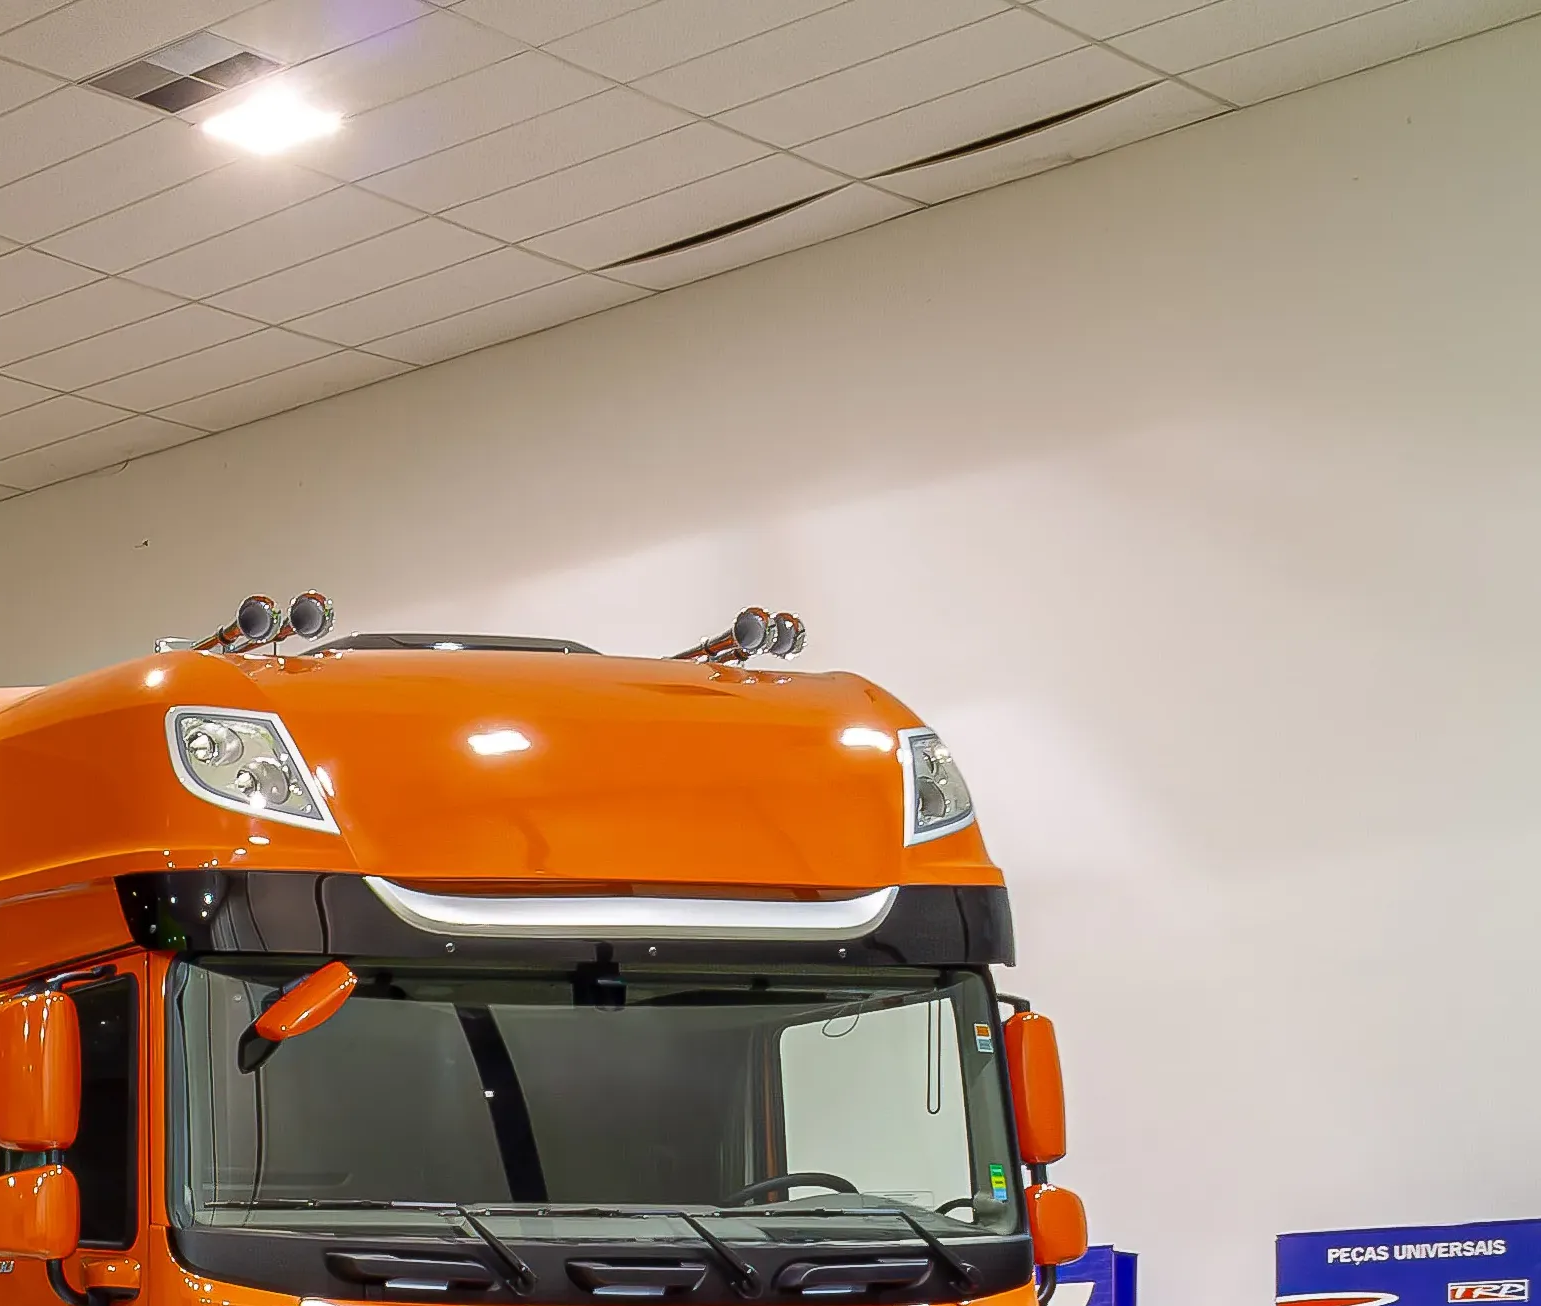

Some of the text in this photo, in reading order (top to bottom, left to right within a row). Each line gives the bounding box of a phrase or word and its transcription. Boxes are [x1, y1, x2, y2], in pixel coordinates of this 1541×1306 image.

[1327, 1239, 1507, 1266] PEÇAS UNIVERSAIS
[1450, 1283, 1527, 1301] TRP
